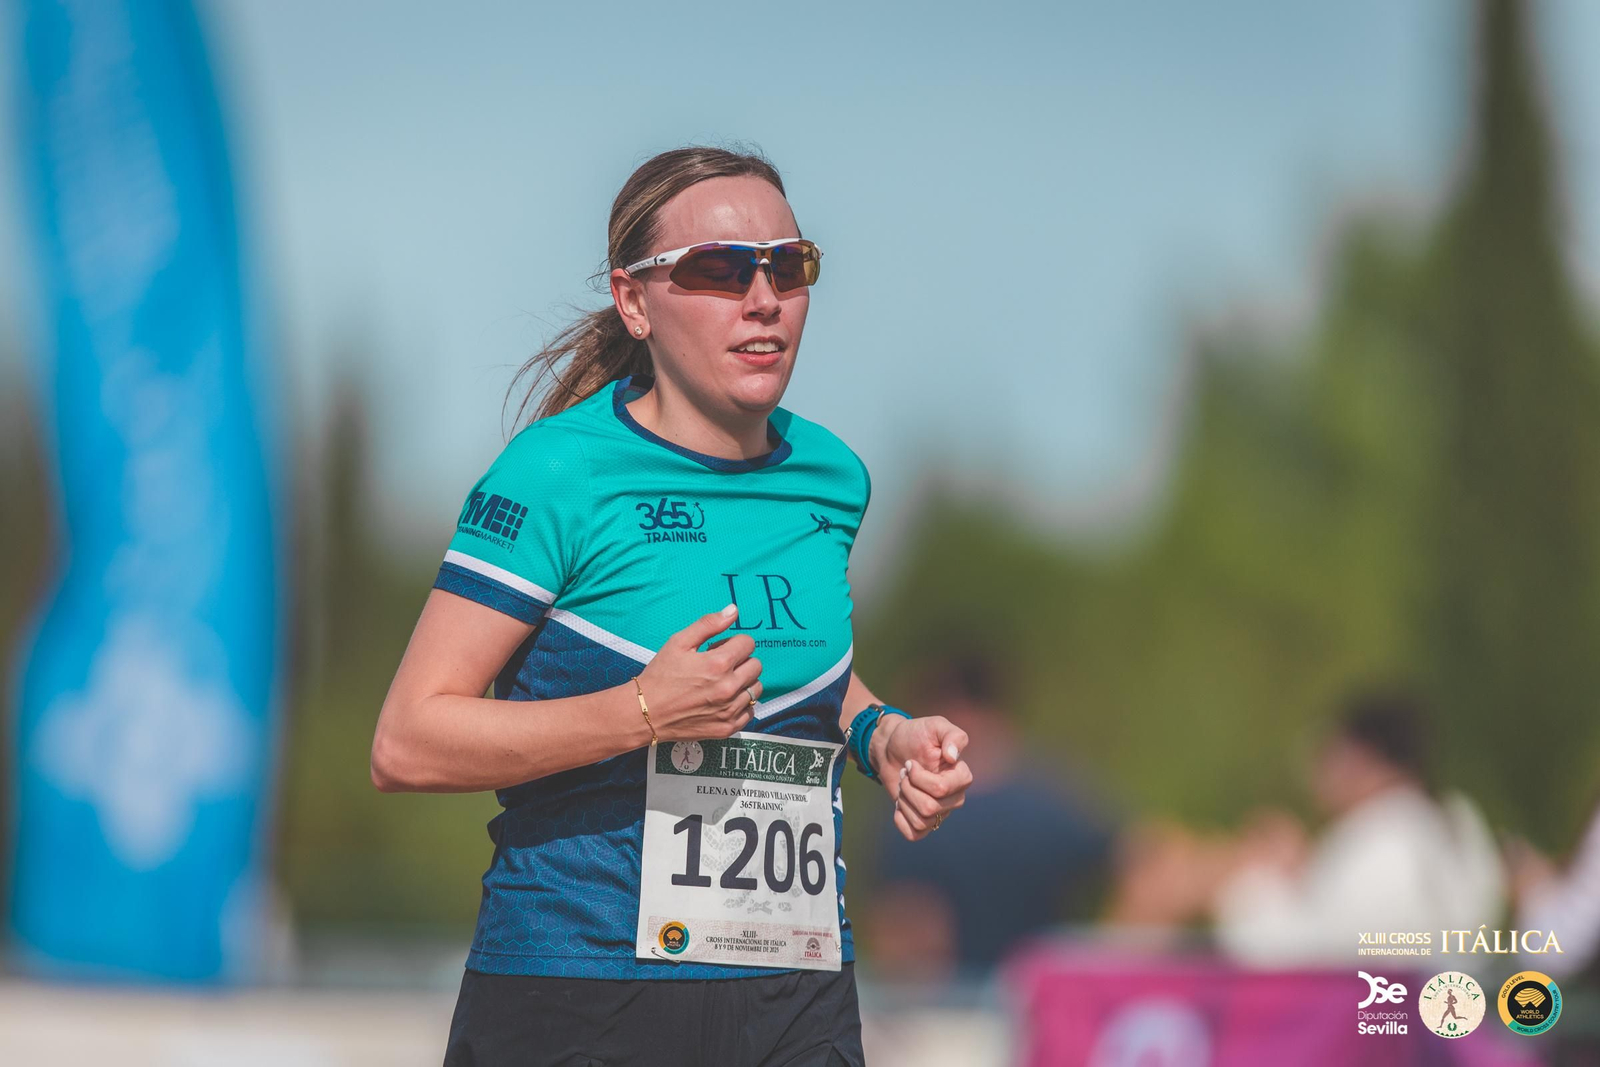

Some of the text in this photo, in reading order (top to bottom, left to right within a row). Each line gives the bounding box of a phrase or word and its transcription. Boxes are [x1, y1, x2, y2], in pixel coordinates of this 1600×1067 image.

[635, 498, 693, 530] 365
[644, 531, 707, 543] TRAINING
[721, 573, 807, 630] LR
[755, 638, 827, 648] artamentos.com
[720, 743, 795, 775] ITÁLICA
[696, 785, 808, 802] ELENA SAMPEDRO VILLAVERDE
[740, 801, 783, 811] 365TRAINING
[671, 814, 826, 895] 1206
[724, 937, 762, 946] INTERNACIONAL
